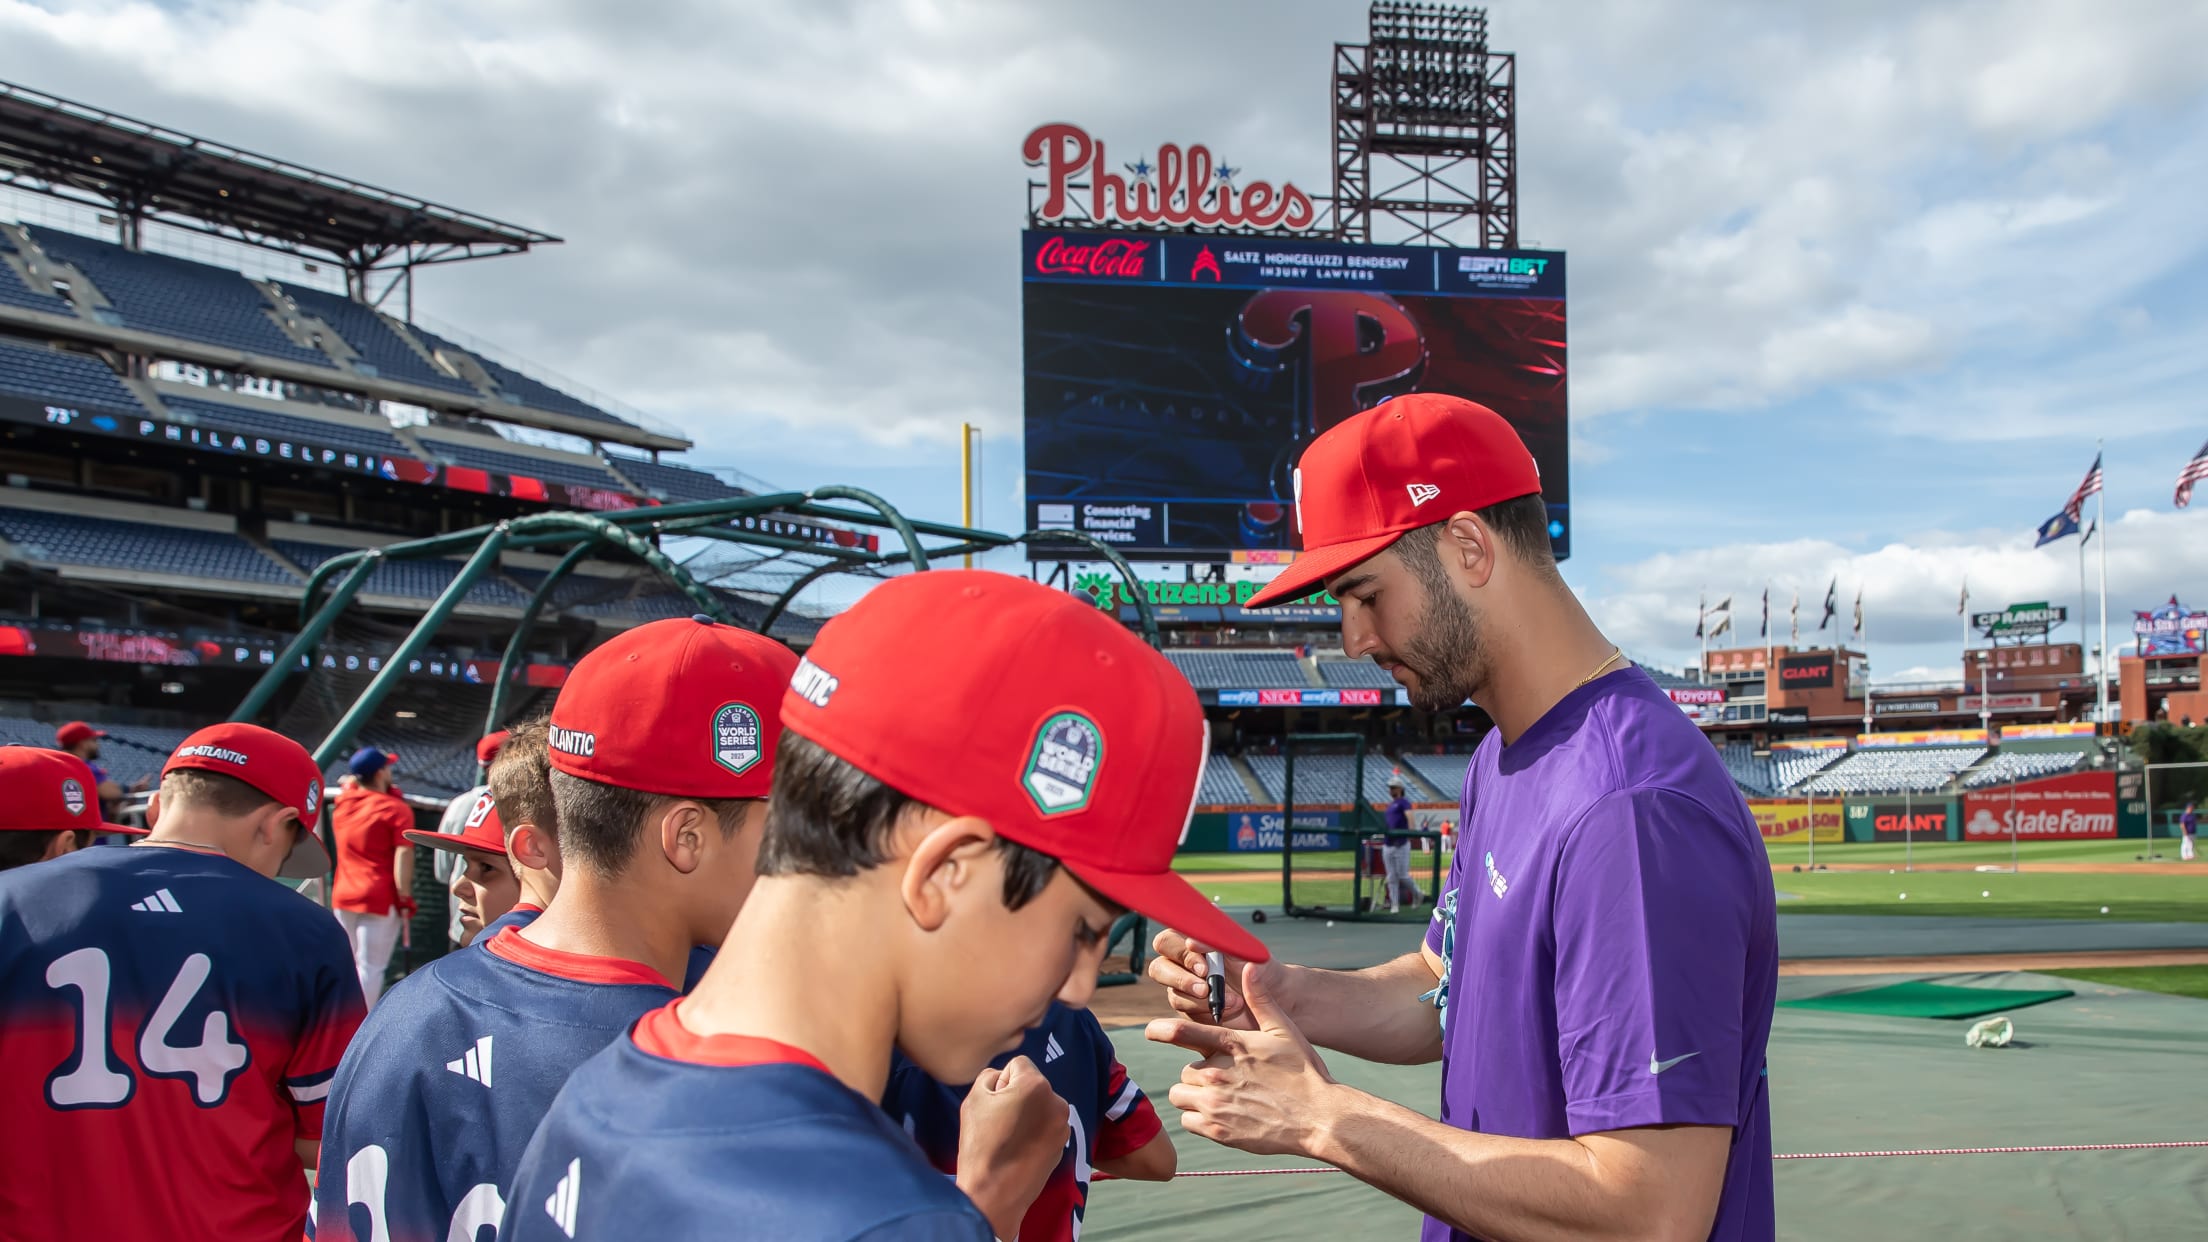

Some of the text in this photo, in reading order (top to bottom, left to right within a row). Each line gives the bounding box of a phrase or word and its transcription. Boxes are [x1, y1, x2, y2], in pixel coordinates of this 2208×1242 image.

[1022, 122, 1314, 231] Phillies
[1036, 236, 1149, 277] Coca-Cola
[1224, 251, 1409, 270] SALTZ MONGELUZZI BENDESKY
[1260, 267, 1375, 281] INJURY LAWYERS
[139, 420, 398, 479] PHILADELPHIA
[1083, 503, 1151, 520] Connecting
[1084, 517, 1136, 530] financial
[1088, 530, 1136, 543] ervices.
[235, 647, 480, 683] PHLADEPHIA
[1782, 665, 1829, 680] GIANT
[1674, 689, 1722, 702] TOYOTA
[718, 727, 757, 737] WORLD
[720, 736, 755, 746] SERIES
[1875, 814, 1946, 832] GIANT
[1258, 831, 1330, 848] WILIAMS.
[46, 947, 248, 1104] 14
